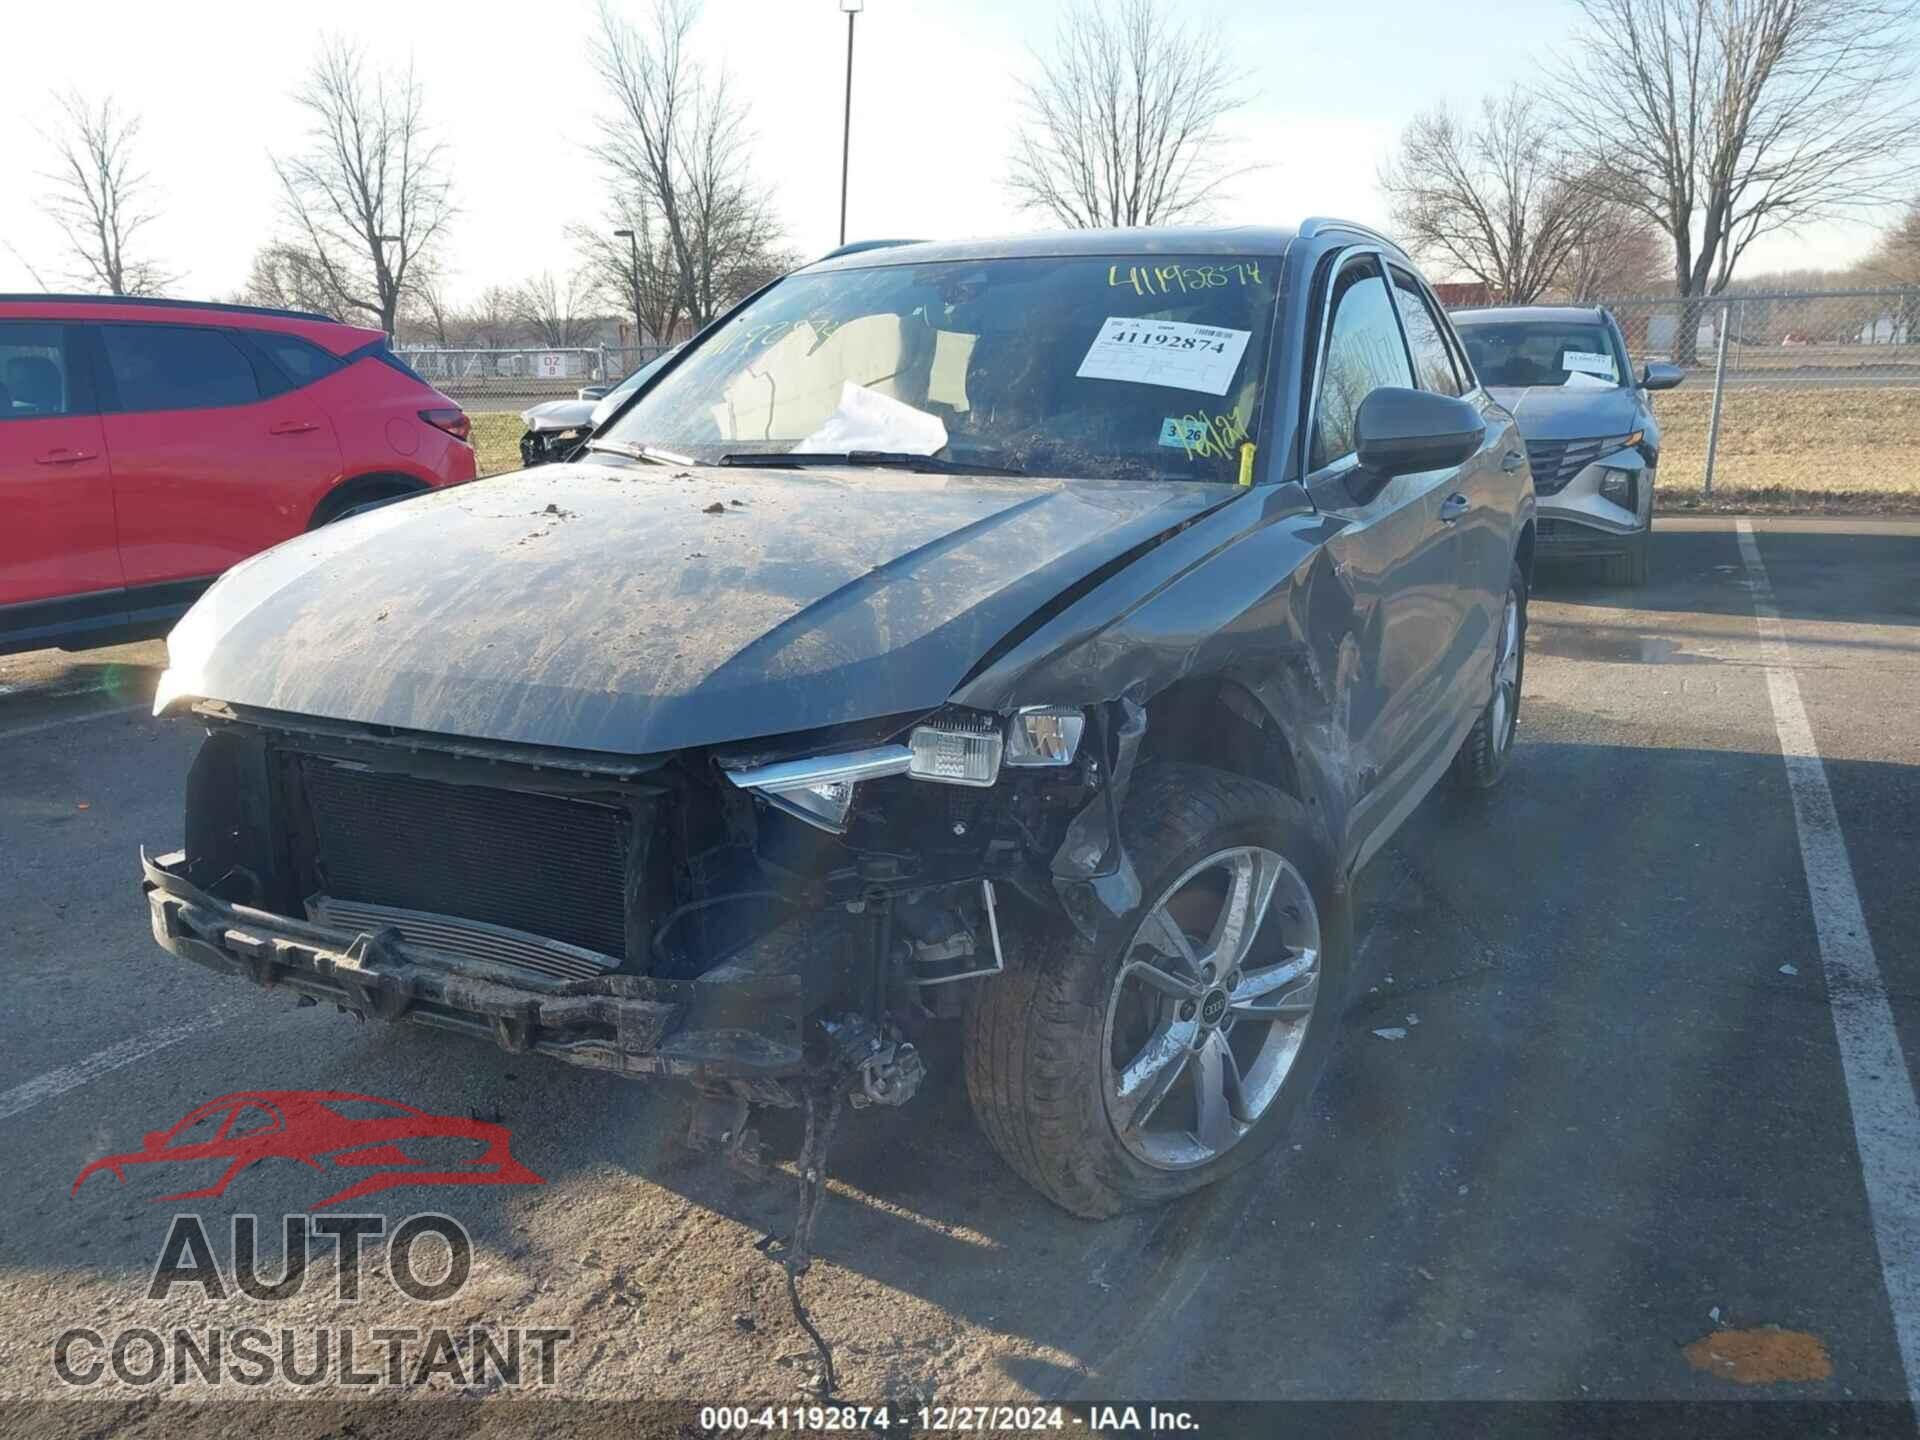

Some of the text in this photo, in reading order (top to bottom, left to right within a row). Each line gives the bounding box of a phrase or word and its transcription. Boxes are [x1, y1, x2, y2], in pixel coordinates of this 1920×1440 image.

[1109, 261, 1263, 296] 41192874
[1112, 330, 1226, 354] 41192874
[1168, 426, 1201, 440] 3 26
